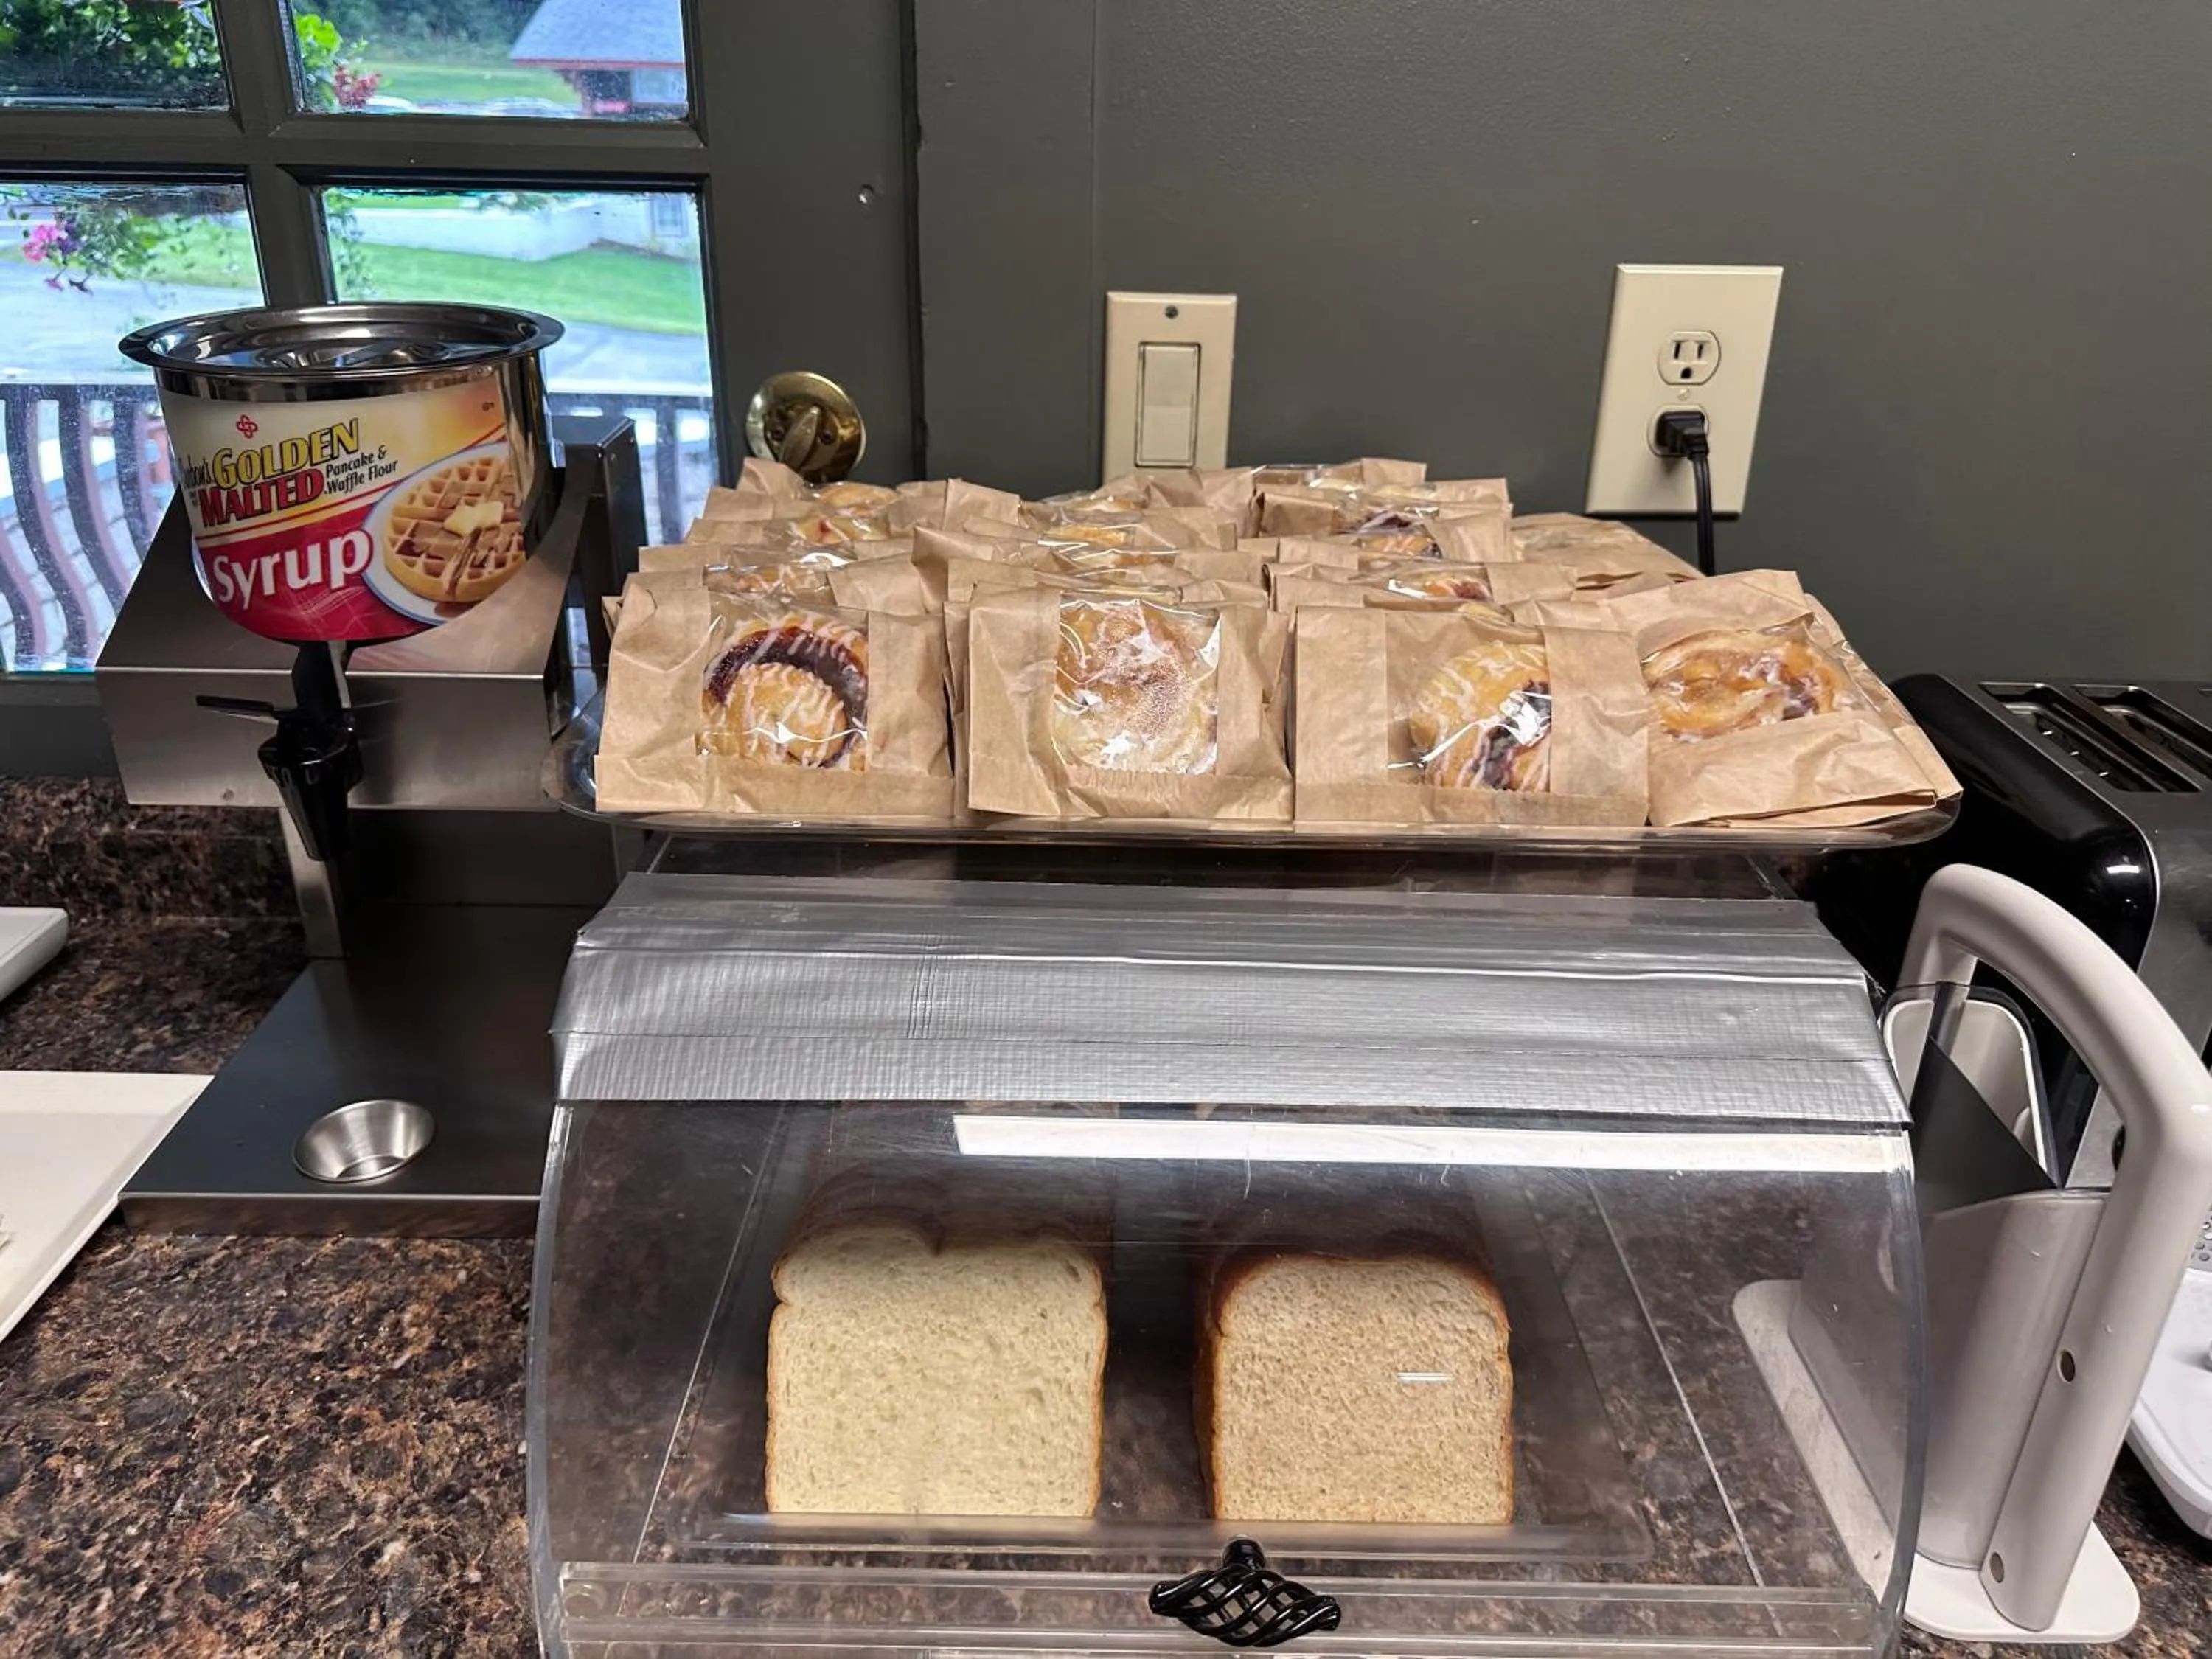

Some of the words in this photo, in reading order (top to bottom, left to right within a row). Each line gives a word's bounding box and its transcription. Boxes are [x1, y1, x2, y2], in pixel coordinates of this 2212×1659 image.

[212, 417, 359, 490] GOLDEN
[326, 452, 374, 479] Pancake
[377, 444, 388, 460] &
[327, 472, 365, 494] Waffle
[368, 460, 399, 480] Flour
[198, 468, 325, 528] MALTED
[213, 529, 374, 611] Syrup
